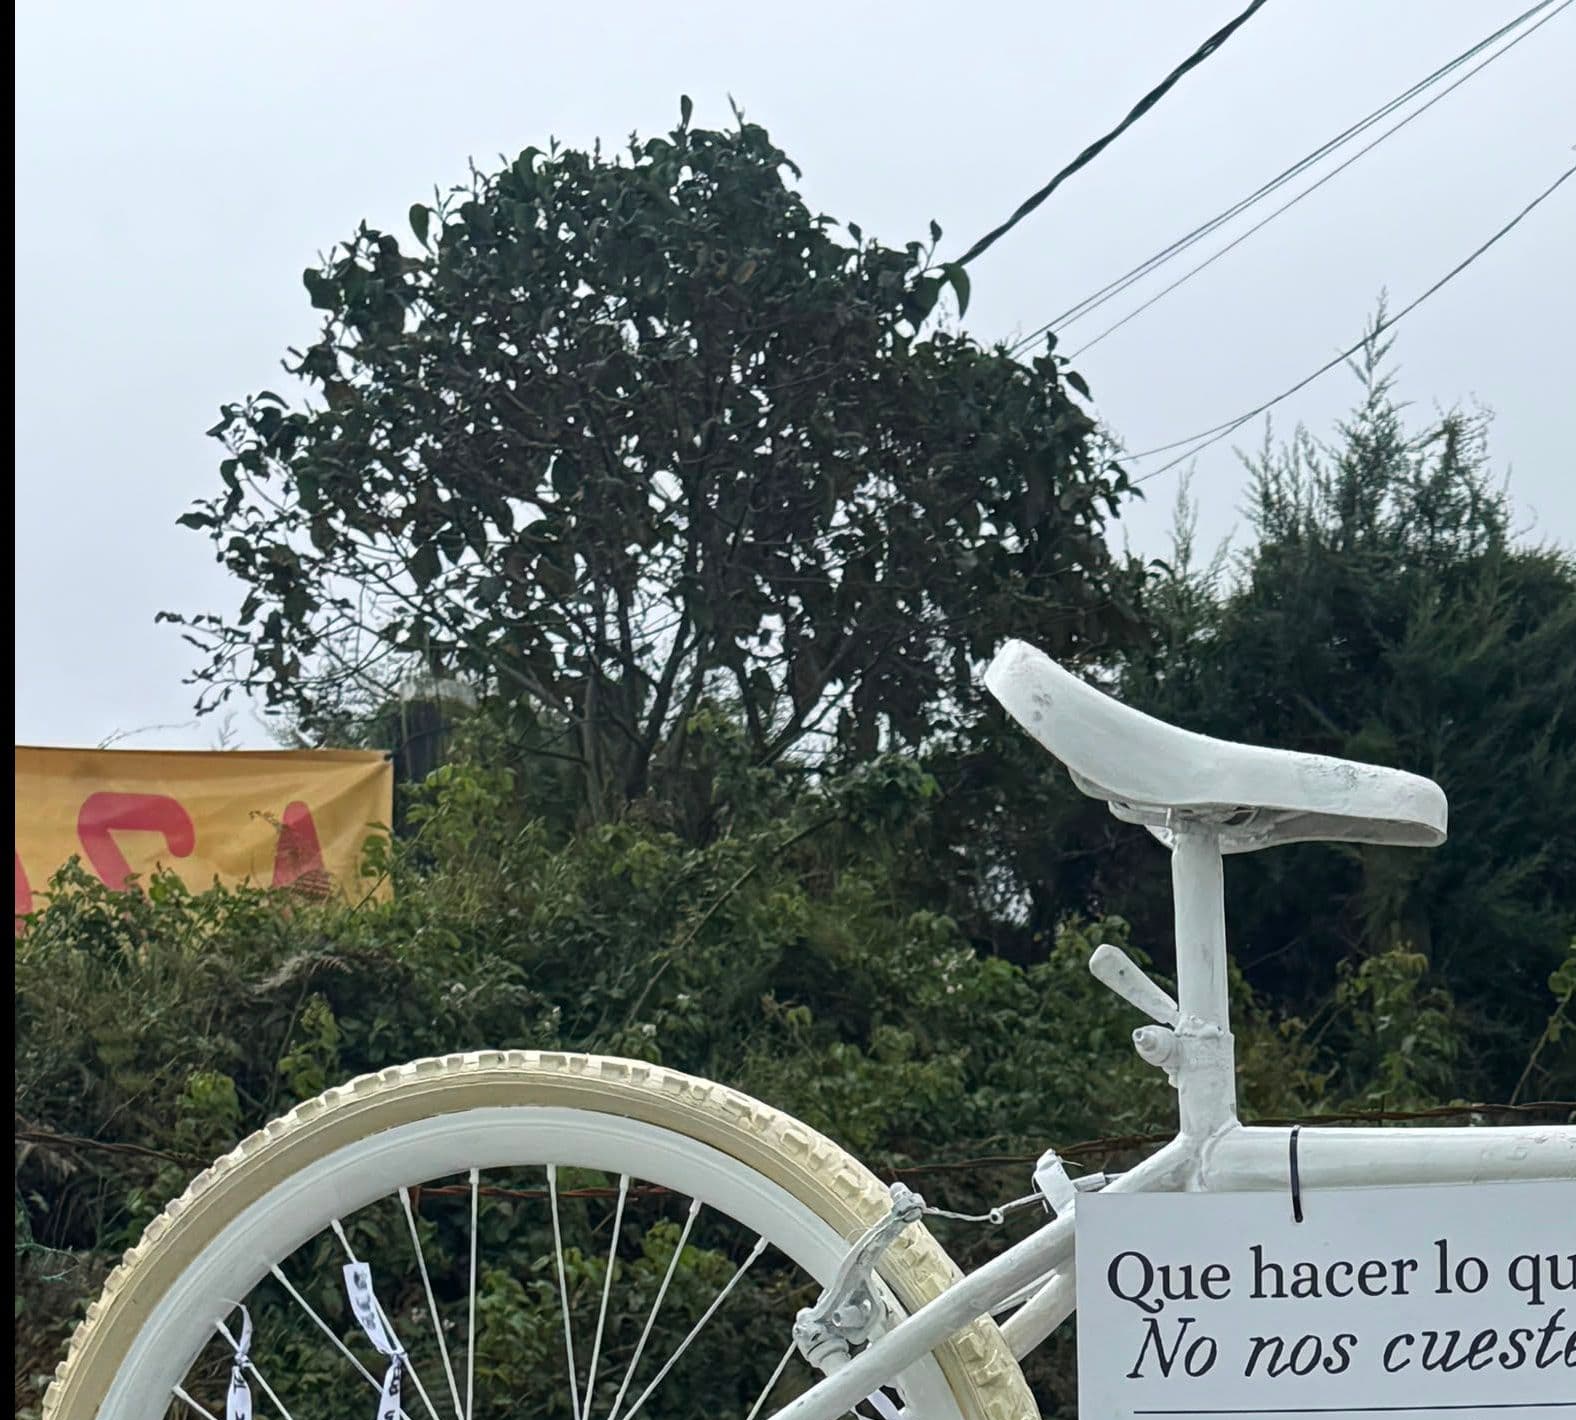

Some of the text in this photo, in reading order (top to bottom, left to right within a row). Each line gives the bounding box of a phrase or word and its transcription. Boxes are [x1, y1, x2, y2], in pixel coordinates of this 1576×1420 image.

[1108, 1251, 1231, 1313] Que
[1249, 1244, 1418, 1298] hacer
[1434, 1239, 1489, 1293] lo
[1126, 1317, 1218, 1378] No
[1244, 1332, 1358, 1378] nos
